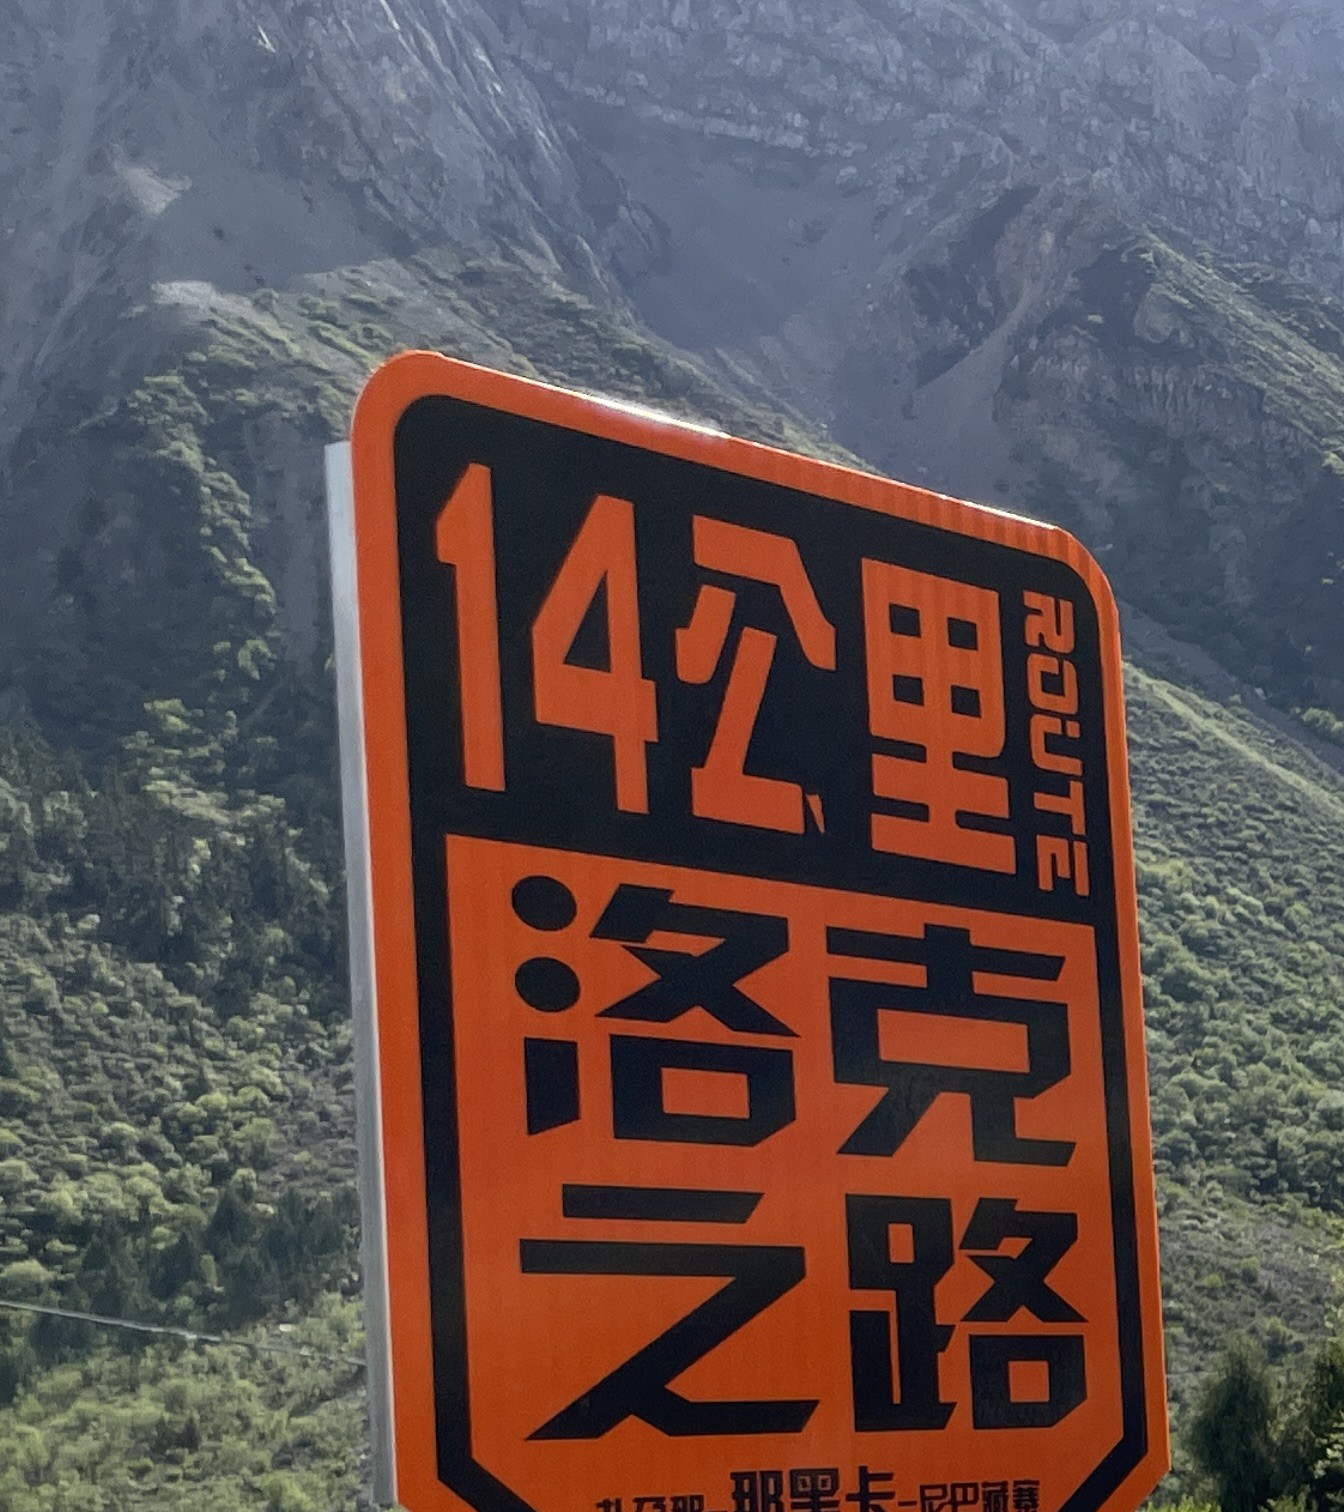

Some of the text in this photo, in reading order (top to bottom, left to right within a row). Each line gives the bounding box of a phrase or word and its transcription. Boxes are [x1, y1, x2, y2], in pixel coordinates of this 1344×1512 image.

[436, 463, 1017, 875] 14公里
[1023, 590, 1090, 896] ROUTE
[511, 883, 1077, 1168] 洛克
[520, 1184, 1089, 1441] 之路
